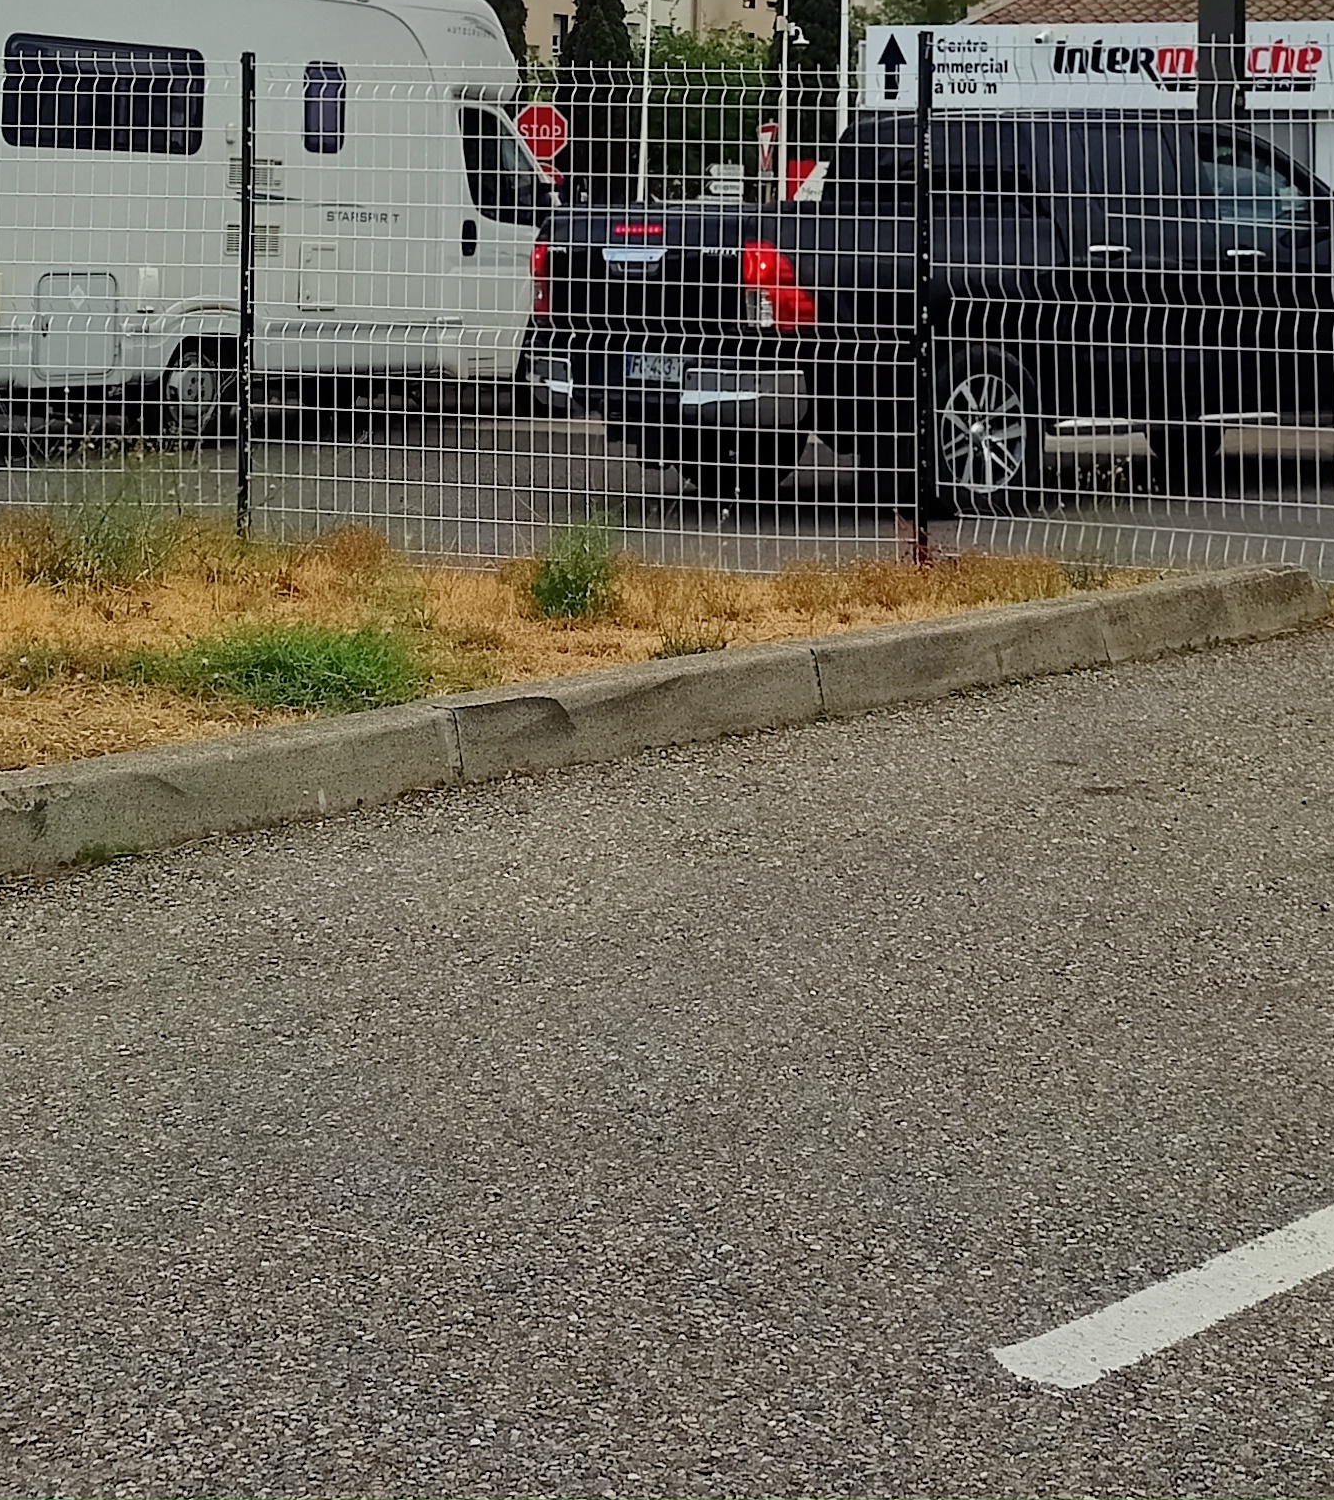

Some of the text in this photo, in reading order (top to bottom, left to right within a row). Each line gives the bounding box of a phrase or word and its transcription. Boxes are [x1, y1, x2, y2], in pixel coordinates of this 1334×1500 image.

[937, 38, 988, 53] Centre
[1053, 39, 1323, 90] Intermché
[519, 123, 562, 138] STOP
